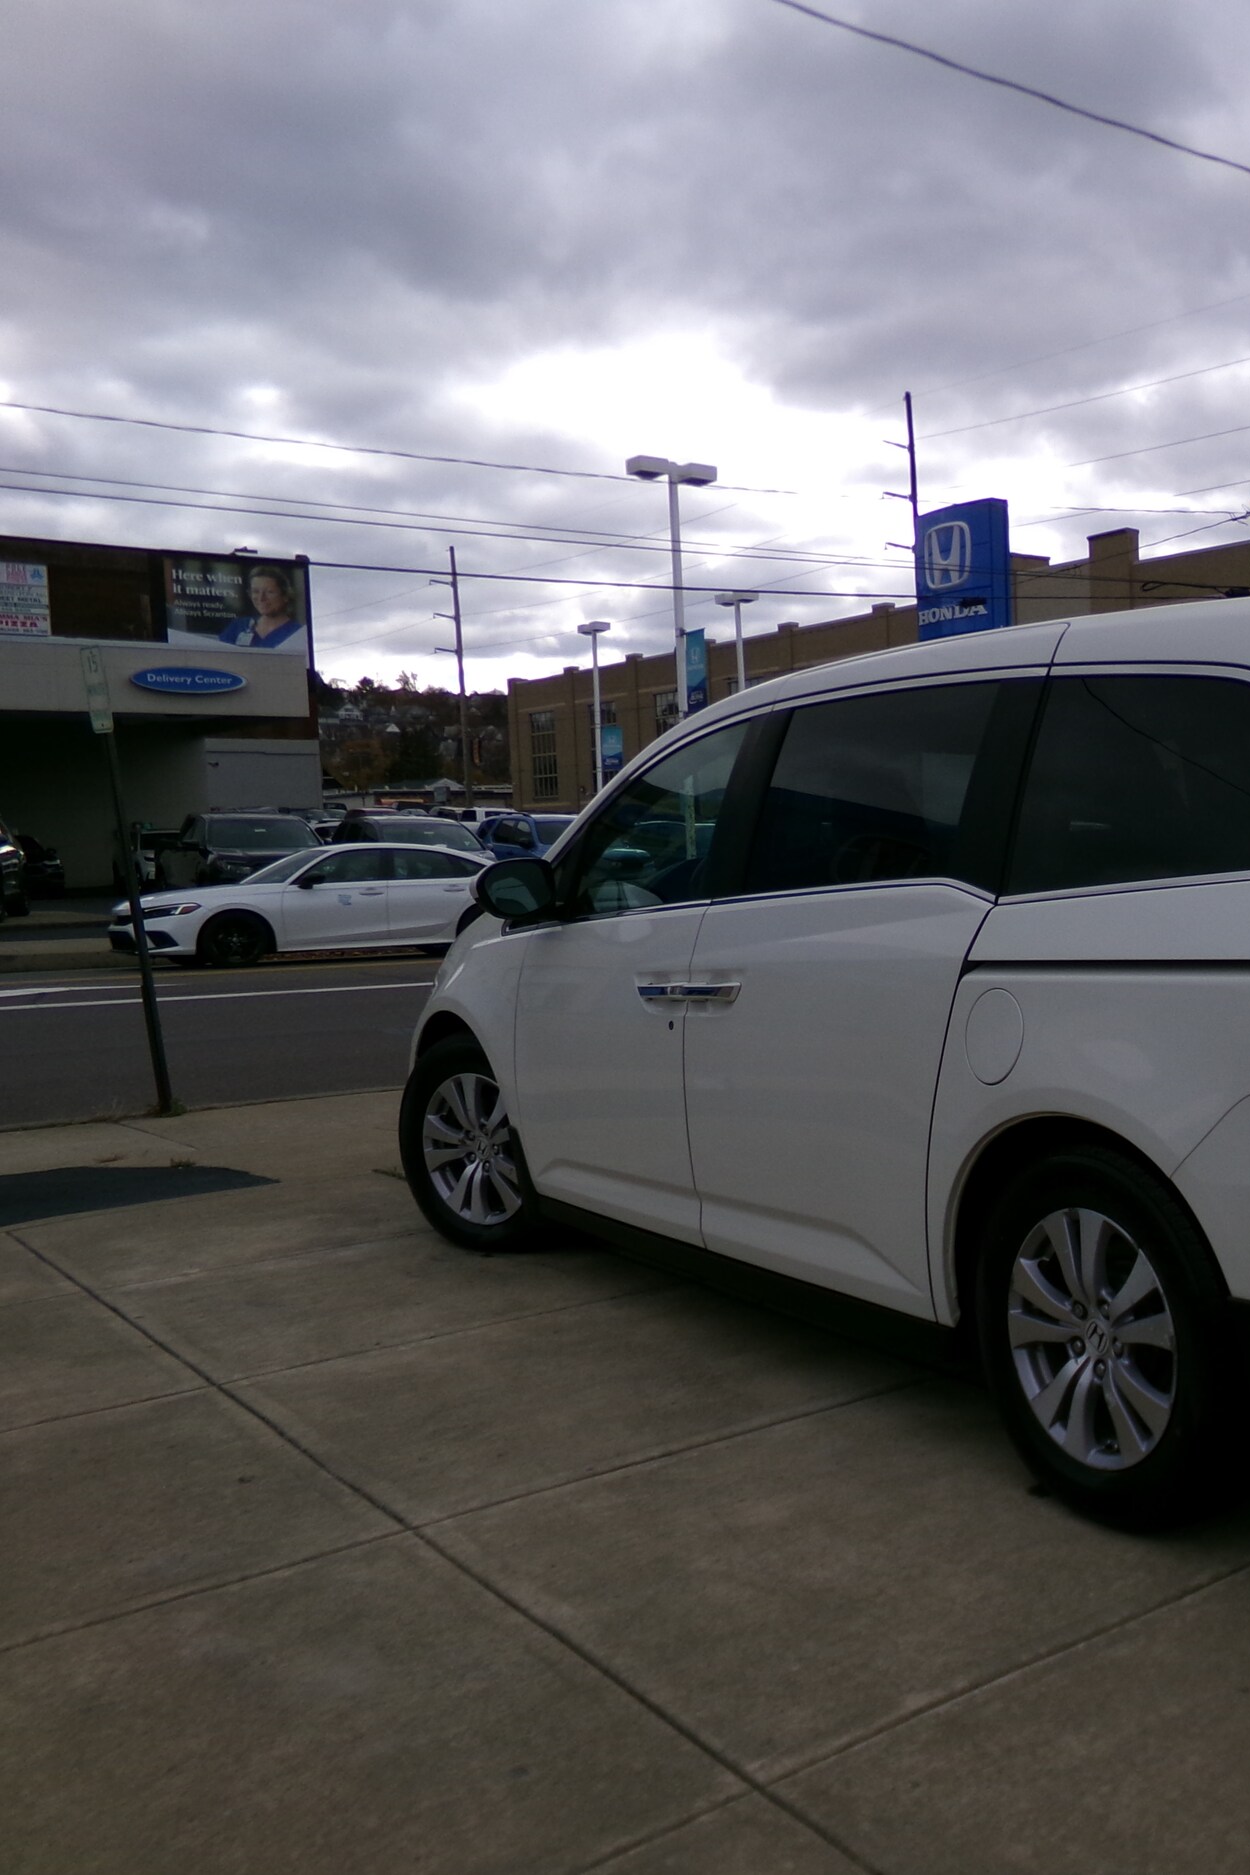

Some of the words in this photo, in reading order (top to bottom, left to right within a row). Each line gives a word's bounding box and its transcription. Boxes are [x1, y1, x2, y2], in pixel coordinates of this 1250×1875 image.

[172, 569, 203, 581] Here
[206, 572, 242, 584] when
[186, 587, 238, 598] matters.
[174, 599, 201, 608] Always
[175, 608, 202, 617] Always
[919, 603, 988, 625] HONDA
[147, 673, 192, 685] Delivery
[195, 675, 232, 684] Center
